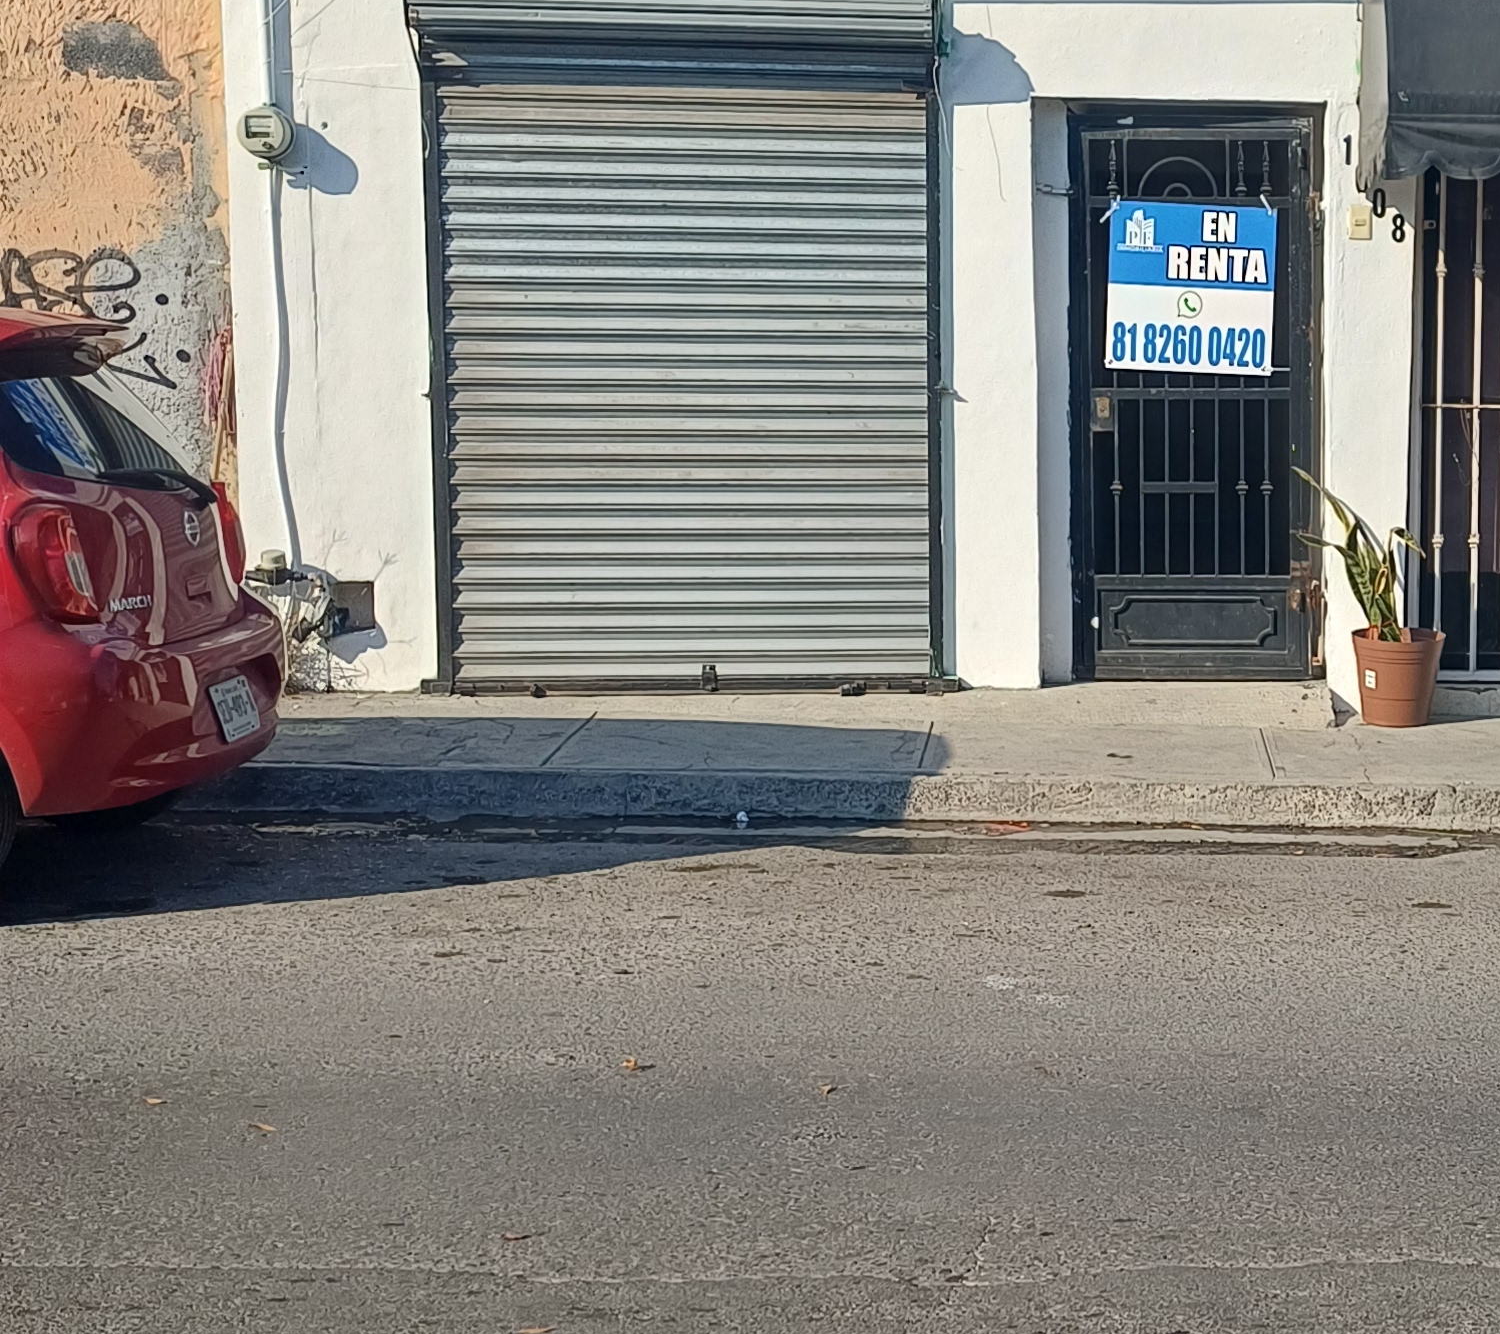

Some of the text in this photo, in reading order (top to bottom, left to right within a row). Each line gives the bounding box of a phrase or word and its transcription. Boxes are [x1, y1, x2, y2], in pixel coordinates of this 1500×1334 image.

[1202, 210, 1237, 243] EN
[1167, 245, 1269, 284] RENTA
[1112, 321, 1266, 368] 81 8260 0420
